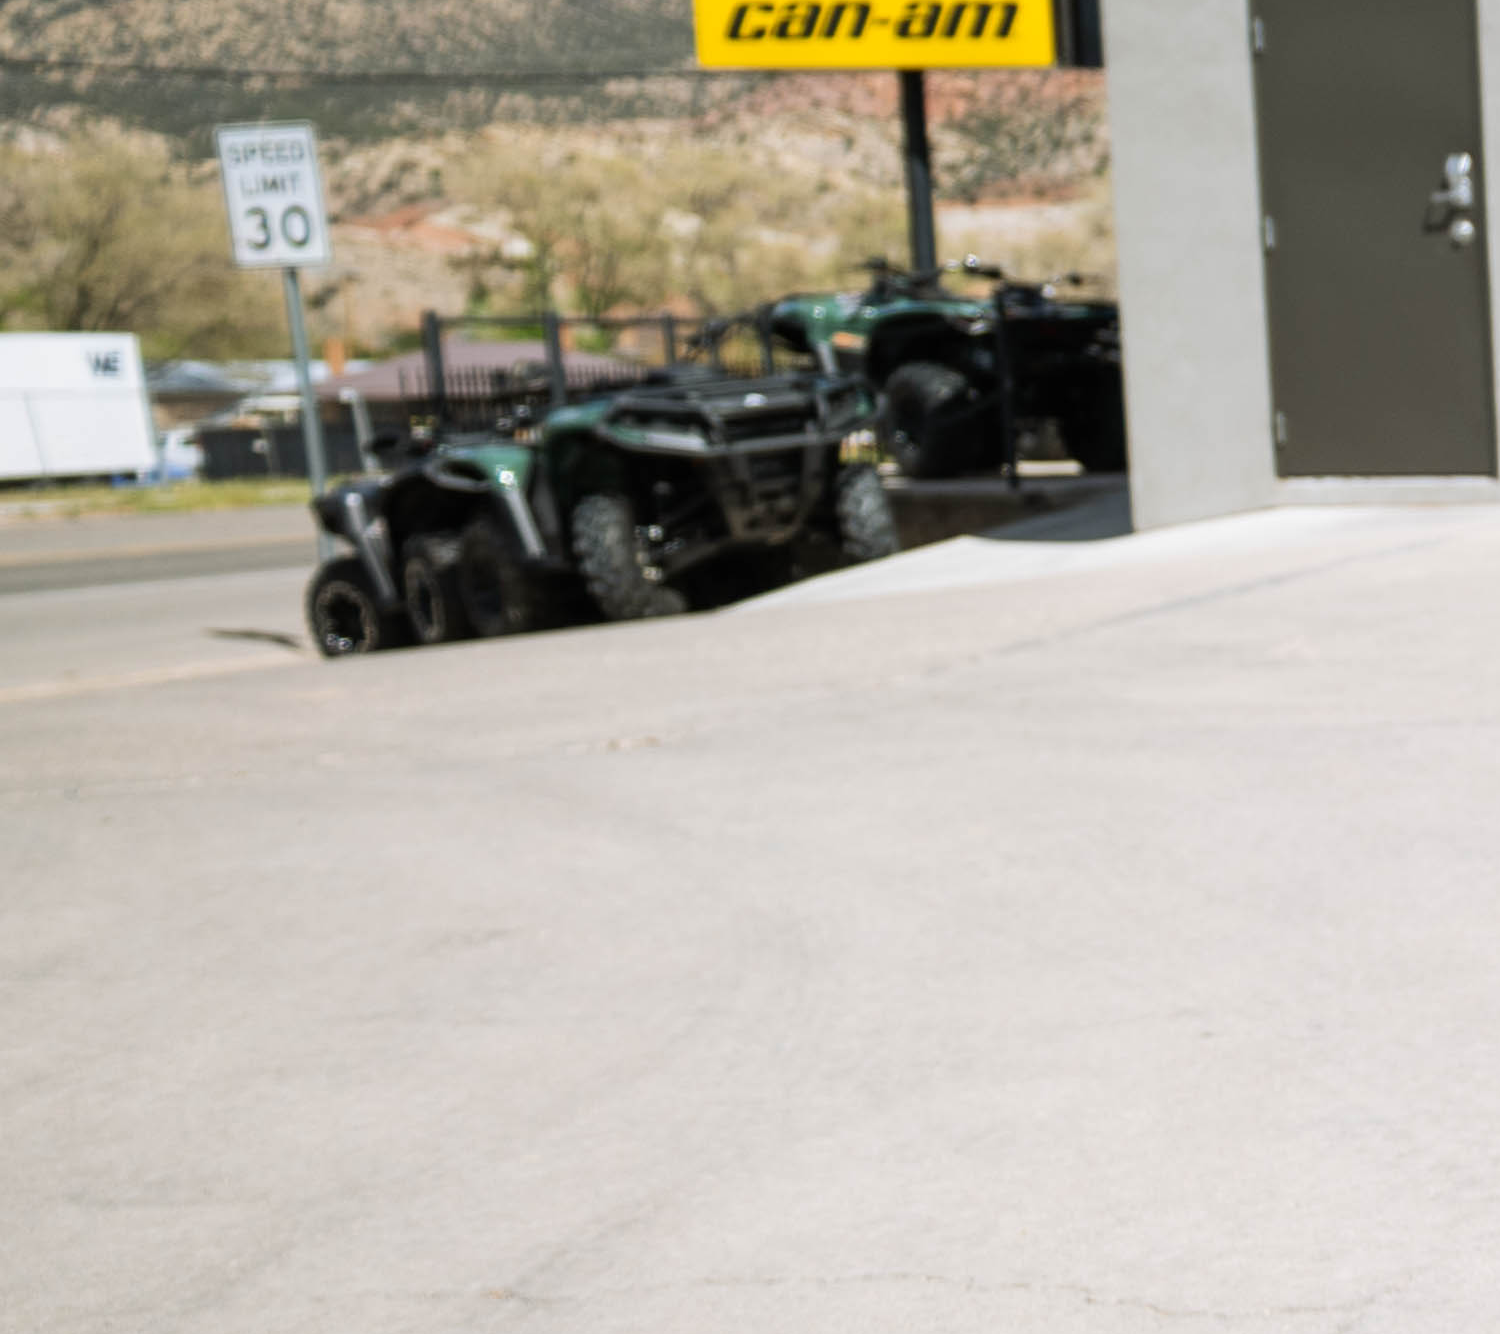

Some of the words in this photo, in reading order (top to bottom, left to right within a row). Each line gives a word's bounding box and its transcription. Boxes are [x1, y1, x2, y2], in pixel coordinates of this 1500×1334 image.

[724, 0, 1019, 41] can-am
[228, 140, 305, 165] SPEED
[240, 171, 300, 197] LIMIT
[246, 204, 310, 250] 30
